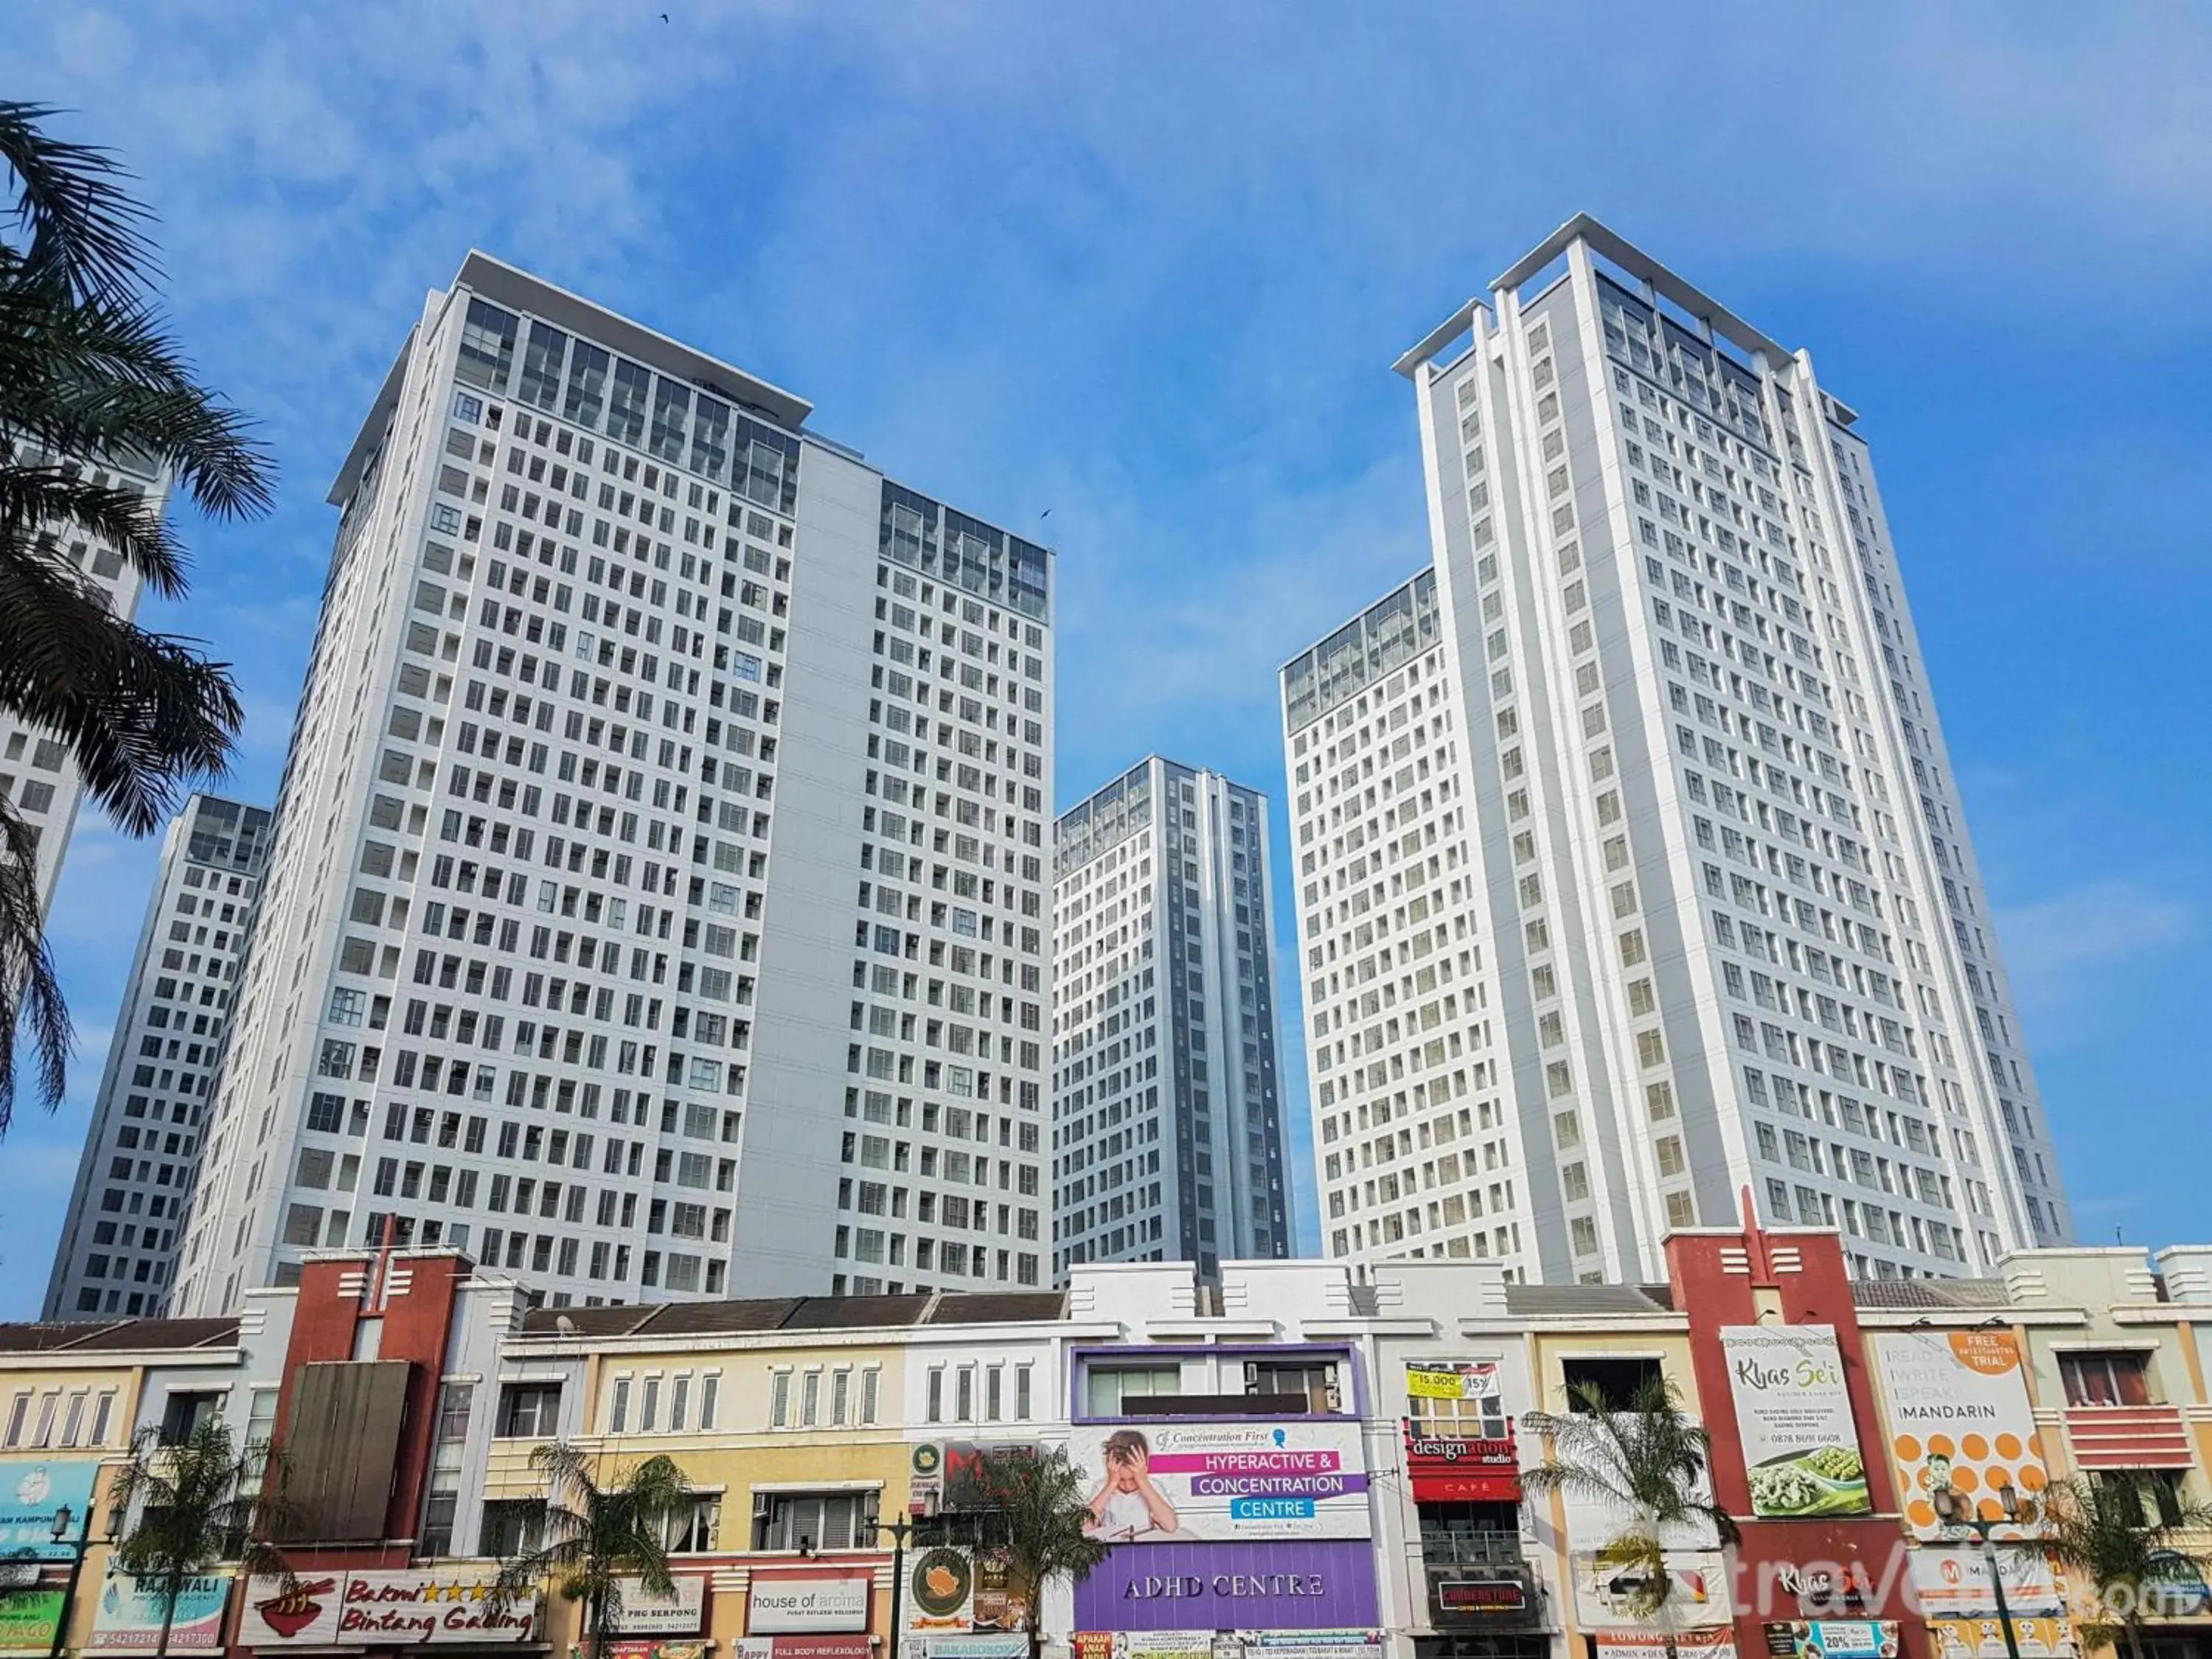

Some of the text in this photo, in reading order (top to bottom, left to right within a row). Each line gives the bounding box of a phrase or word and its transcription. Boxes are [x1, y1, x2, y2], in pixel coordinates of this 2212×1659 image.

[1968, 1335, 1998, 1346] FREE
[1971, 1356, 2006, 1366] TRIAL
[1735, 1357, 1790, 1390] Khas
[1173, 1430, 1268, 1443] Concentration First
[1413, 1439, 1509, 1460] designation
[1206, 1453, 1332, 1470] HYPERACTIVE &
[1481, 1455, 1511, 1464] studio
[1200, 1477, 1343, 1494] CONCENTRATION
[1239, 1501, 1305, 1517] CENTRE
[135, 1577, 219, 1593] RAJWALI
[345, 1579, 425, 1603] Bakmi
[1124, 1575, 1325, 1599] ADHD CENTRE
[754, 1595, 797, 1608] house
[802, 1594, 815, 1608] of
[651, 1608, 697, 1617] SERPONG
[340, 1607, 437, 1643] Bintang
[1825, 1635, 1850, 1648] 20%
[775, 1646, 870, 1655] FULL BODY REFLEXOLOGY
